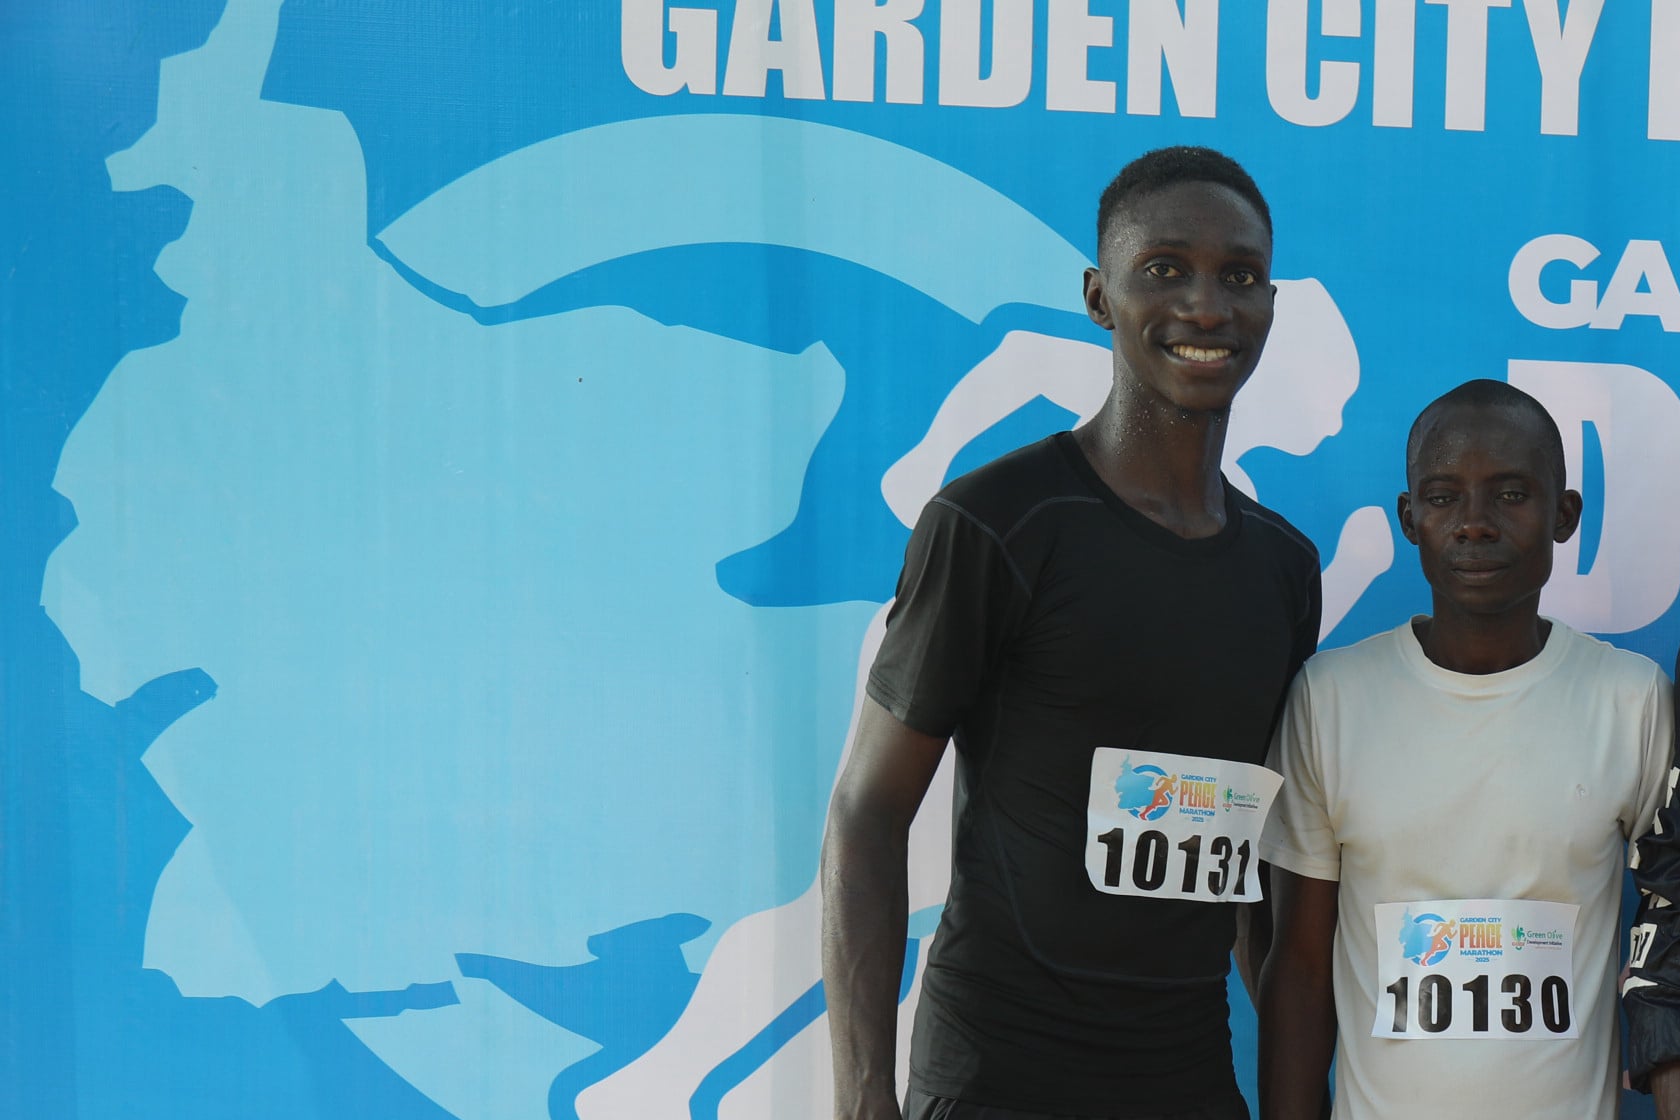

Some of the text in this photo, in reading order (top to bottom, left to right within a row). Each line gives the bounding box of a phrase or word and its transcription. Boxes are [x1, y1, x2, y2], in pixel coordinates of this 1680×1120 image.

[621, 0, 1218, 118] GARDEN
[1265, 0, 1601, 137] CITY
[1179, 781, 1217, 808] PEACE
[1097, 827, 1251, 896] 10131
[1459, 924, 1502, 948] PEACE
[1386, 974, 1571, 1033] 10130
